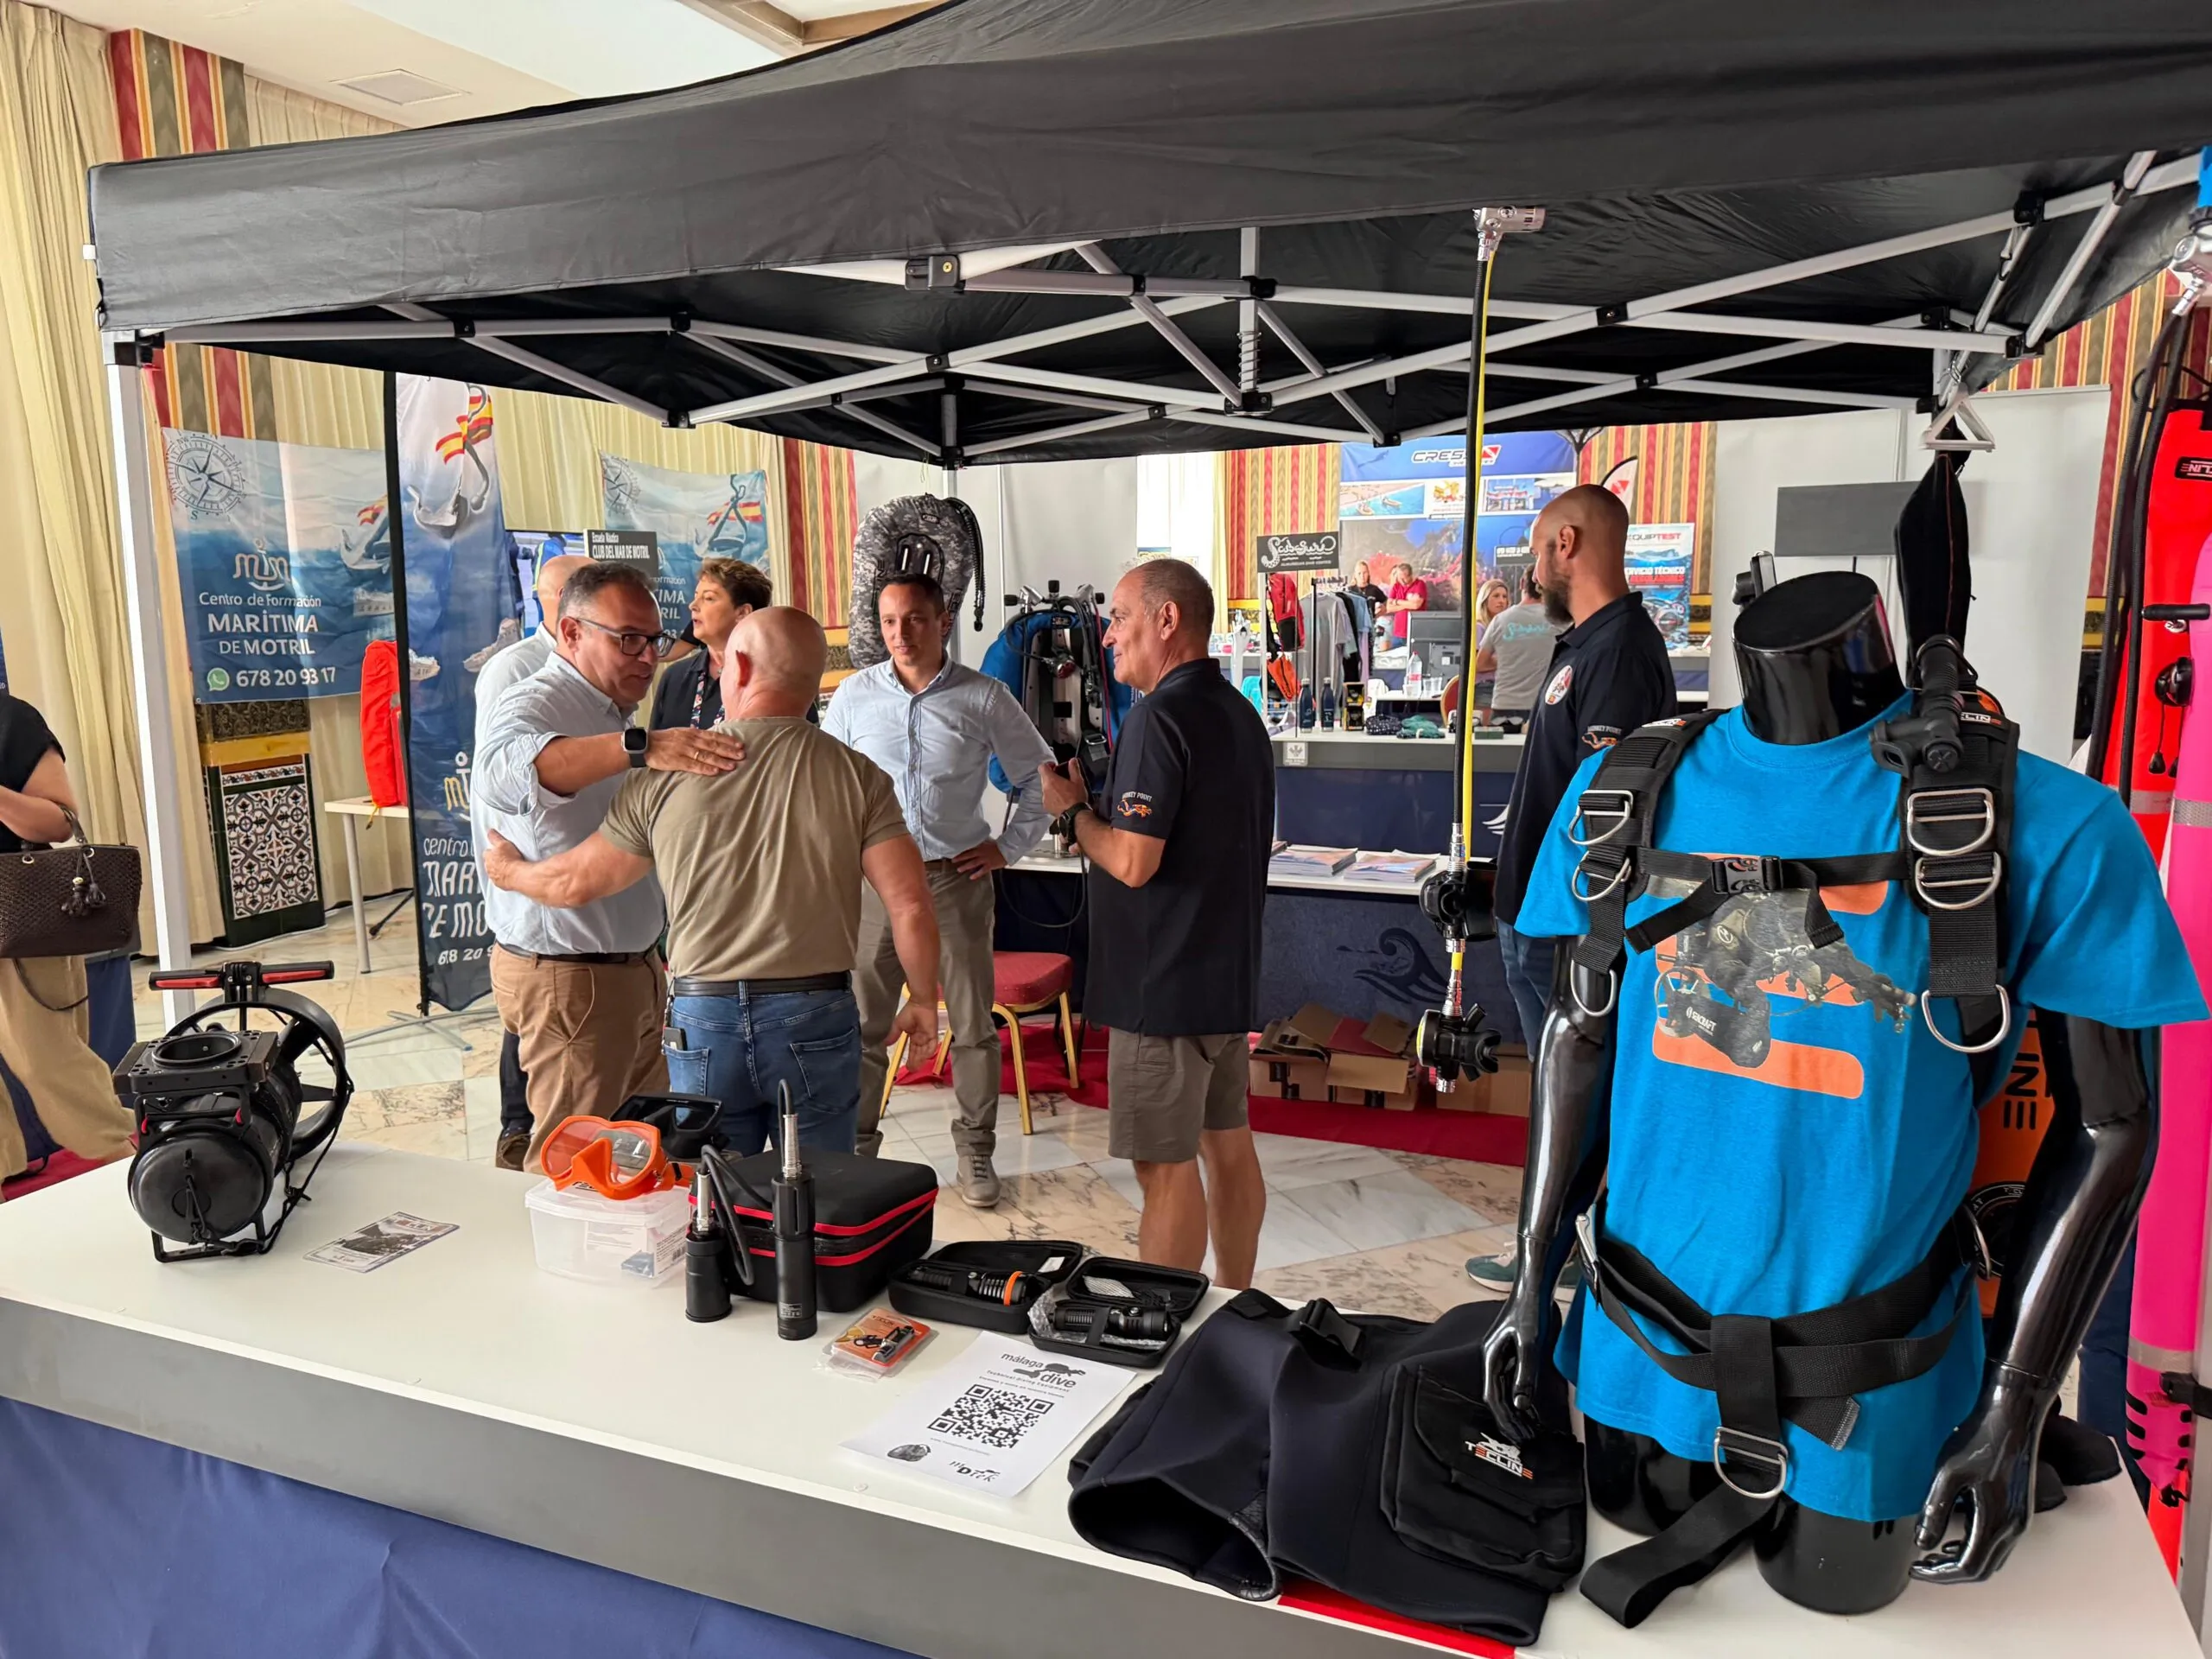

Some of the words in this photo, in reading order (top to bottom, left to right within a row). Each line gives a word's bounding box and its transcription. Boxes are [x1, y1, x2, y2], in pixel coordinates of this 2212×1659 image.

[592, 544, 605, 559] CLUB
[605, 544, 615, 559] DEL
[614, 545, 626, 559] MAR
[626, 545, 632, 559] DE
[632, 545, 651, 559] MOTRIL
[199, 592, 243, 606] Centro
[247, 593, 264, 606] de
[266, 594, 321, 607] Formación
[219, 640, 241, 655] DE
[244, 639, 316, 656] MOTRIL
[236, 670, 270, 687] 678
[274, 669, 296, 687] 20
[300, 668, 319, 685] 93
[321, 666, 336, 684] 17
[462, 948, 484, 962] 20
[1001, 1353, 1045, 1369] málaga
[1039, 1373, 1077, 1389] dive
